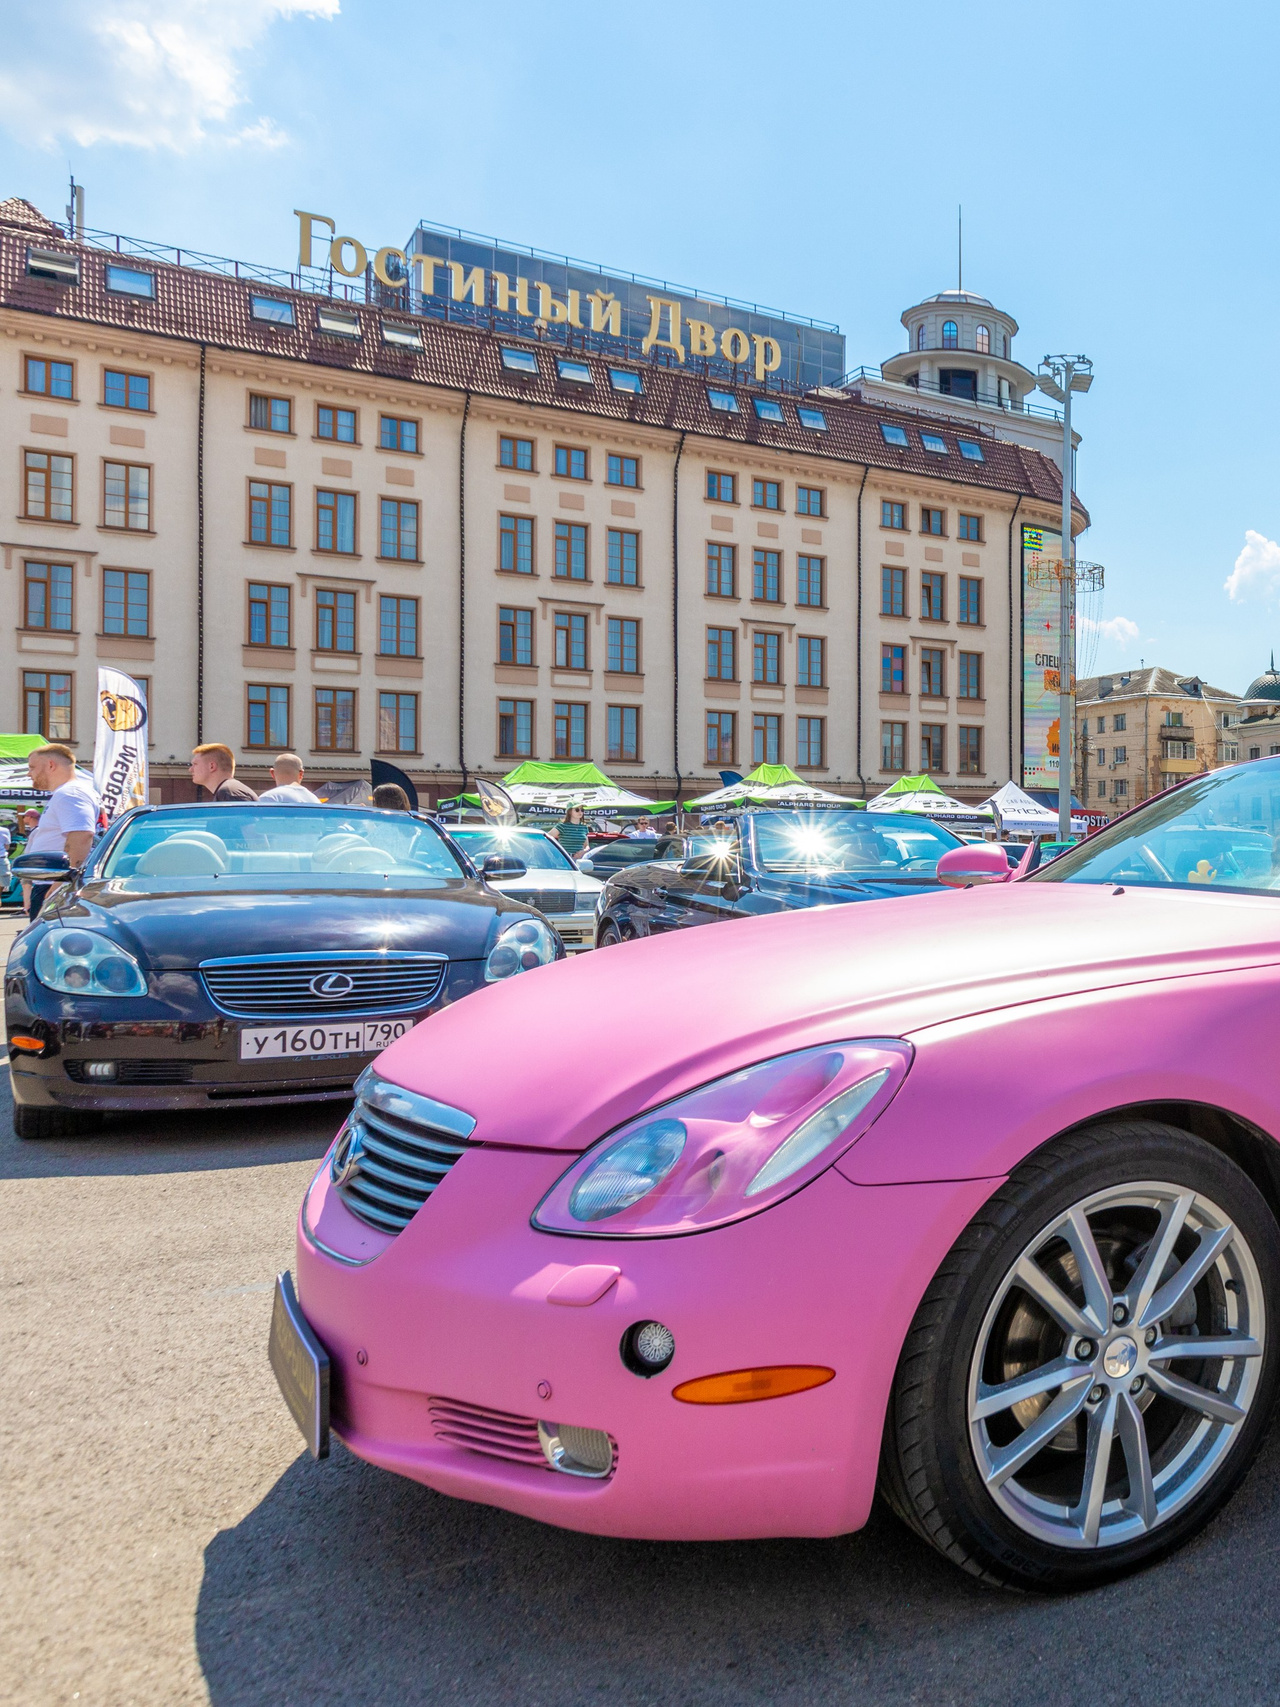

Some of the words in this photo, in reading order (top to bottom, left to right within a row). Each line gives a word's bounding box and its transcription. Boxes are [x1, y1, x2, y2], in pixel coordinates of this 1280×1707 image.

[293, 209, 622, 337] Гостиный
[641, 294, 783, 381] Двор
[1034, 652, 1060, 671] СПЕЦ
[1, 789, 53, 797] GROUP
[528, 806, 567, 814] ALPHA
[584, 808, 618, 816] GROUP
[1002, 807, 1049, 815] Pride
[367, 1022, 406, 1042] 790
[254, 1028, 360, 1054] У160ТН
[310, 1053, 349, 1061] LEXUS
